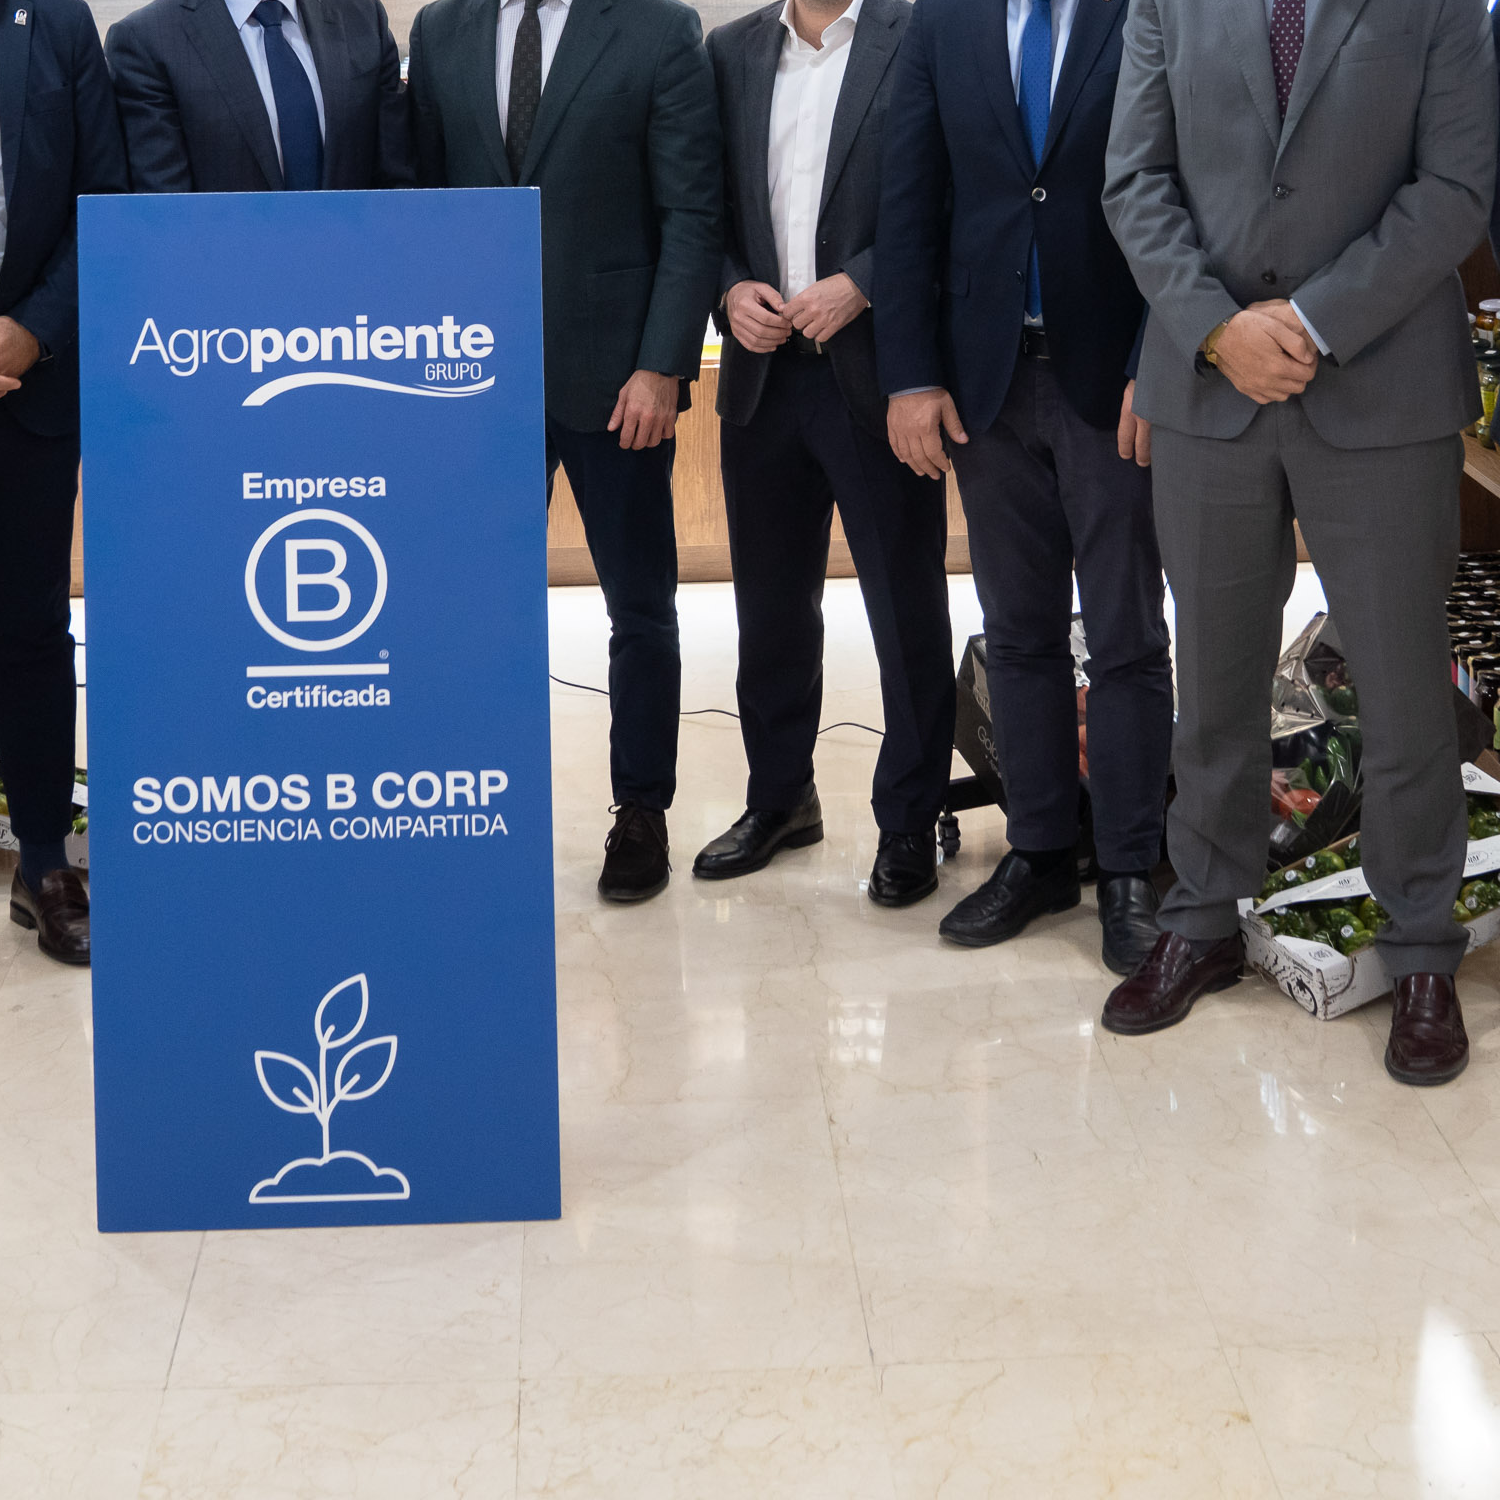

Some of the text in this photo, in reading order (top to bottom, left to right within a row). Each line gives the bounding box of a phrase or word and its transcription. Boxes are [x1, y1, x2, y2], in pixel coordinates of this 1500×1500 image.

[129, 315, 495, 377] Agroponiente
[425, 362, 482, 381] GRUPO
[242, 472, 387, 505] Empresa
[285, 538, 352, 623] B
[246, 684, 391, 709] Certificada
[132, 769, 509, 814] SOMOS B CORP
[133, 813, 509, 845] CONSCIENCIA COMPARTIDA
